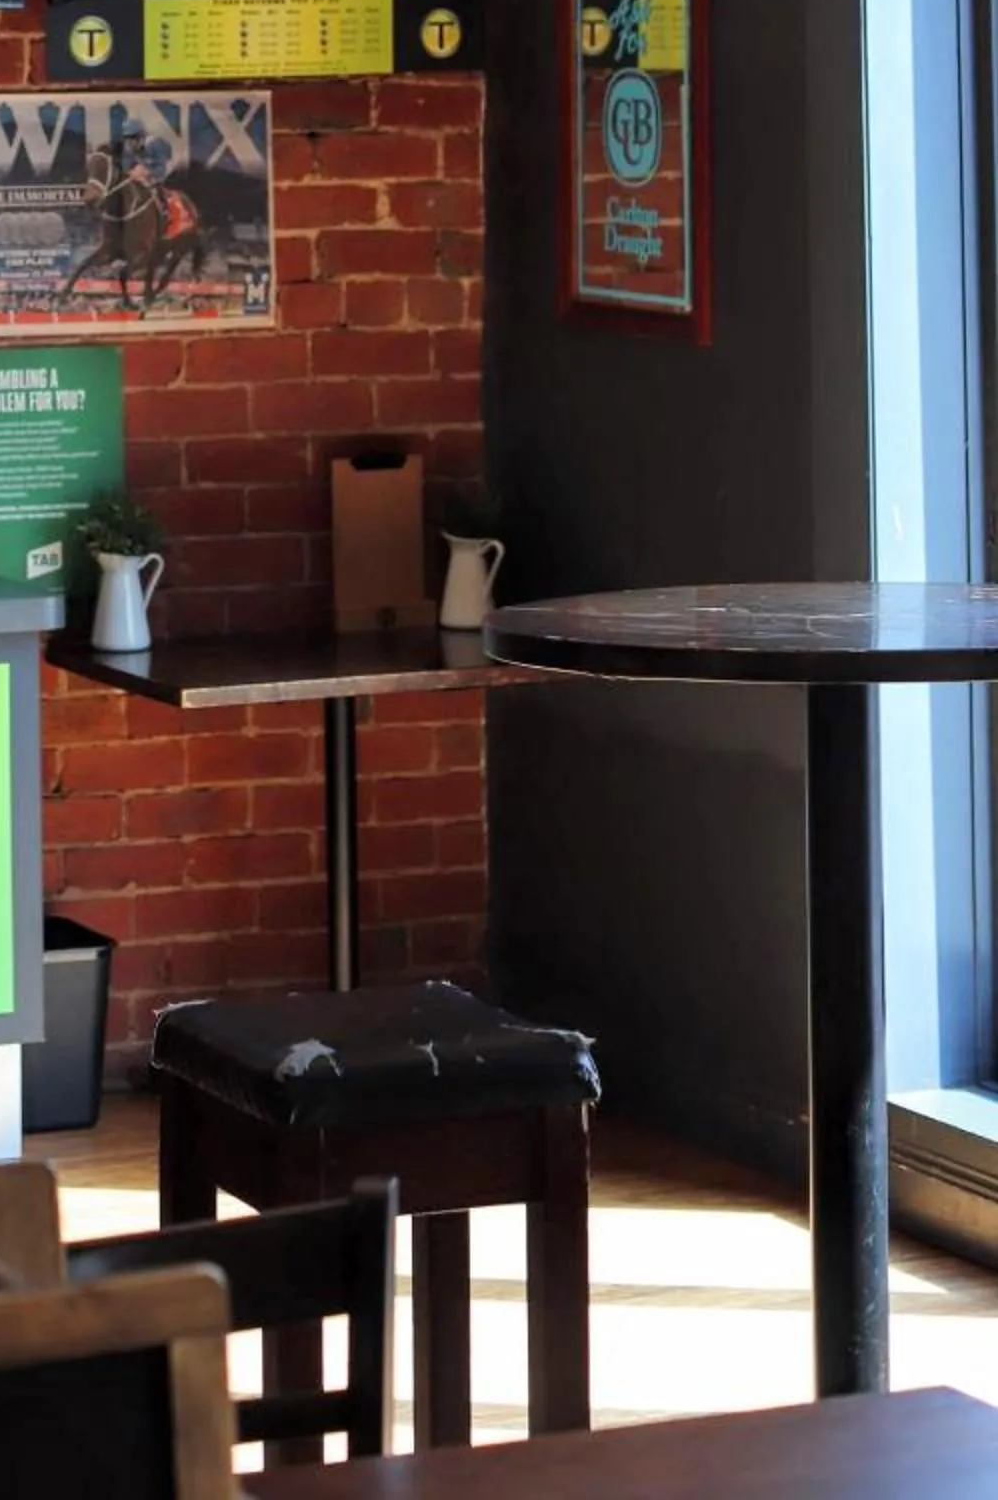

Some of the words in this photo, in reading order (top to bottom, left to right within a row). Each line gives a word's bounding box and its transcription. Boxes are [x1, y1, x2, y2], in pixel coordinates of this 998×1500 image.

[50, 367, 60, 388] A
[29, 391, 53, 412] FOR
[55, 389, 86, 411] YOU?
[31, 551, 60, 567] TAB
